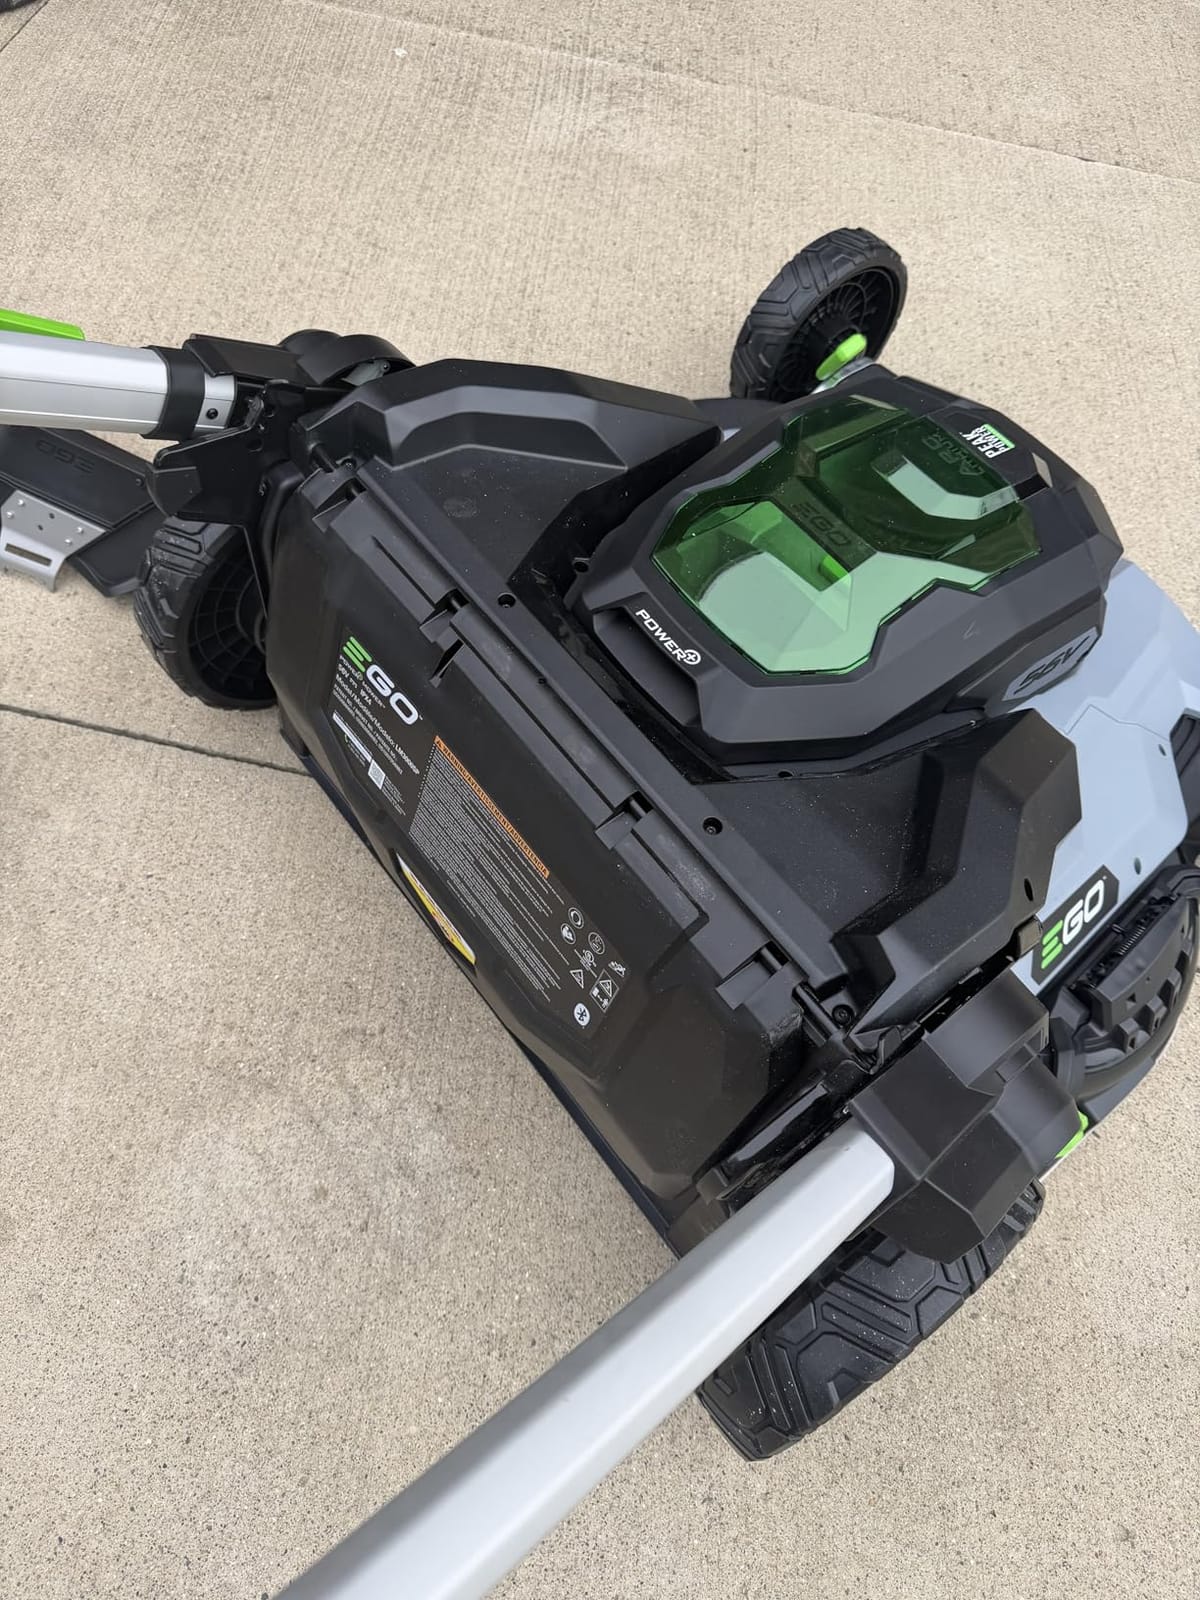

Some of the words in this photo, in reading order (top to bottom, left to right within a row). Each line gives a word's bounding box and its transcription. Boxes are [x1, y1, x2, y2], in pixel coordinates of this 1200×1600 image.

[36, 440, 95, 473] EGO
[922, 434, 981, 476] ARC
[962, 428, 1001, 458] PEAK
[973, 425, 1010, 453] POWER
[792, 502, 851, 546] EGO
[342, 636, 419, 725] EGO
[1013, 635, 1090, 694] 56V
[1041, 879, 1105, 969] EGO
